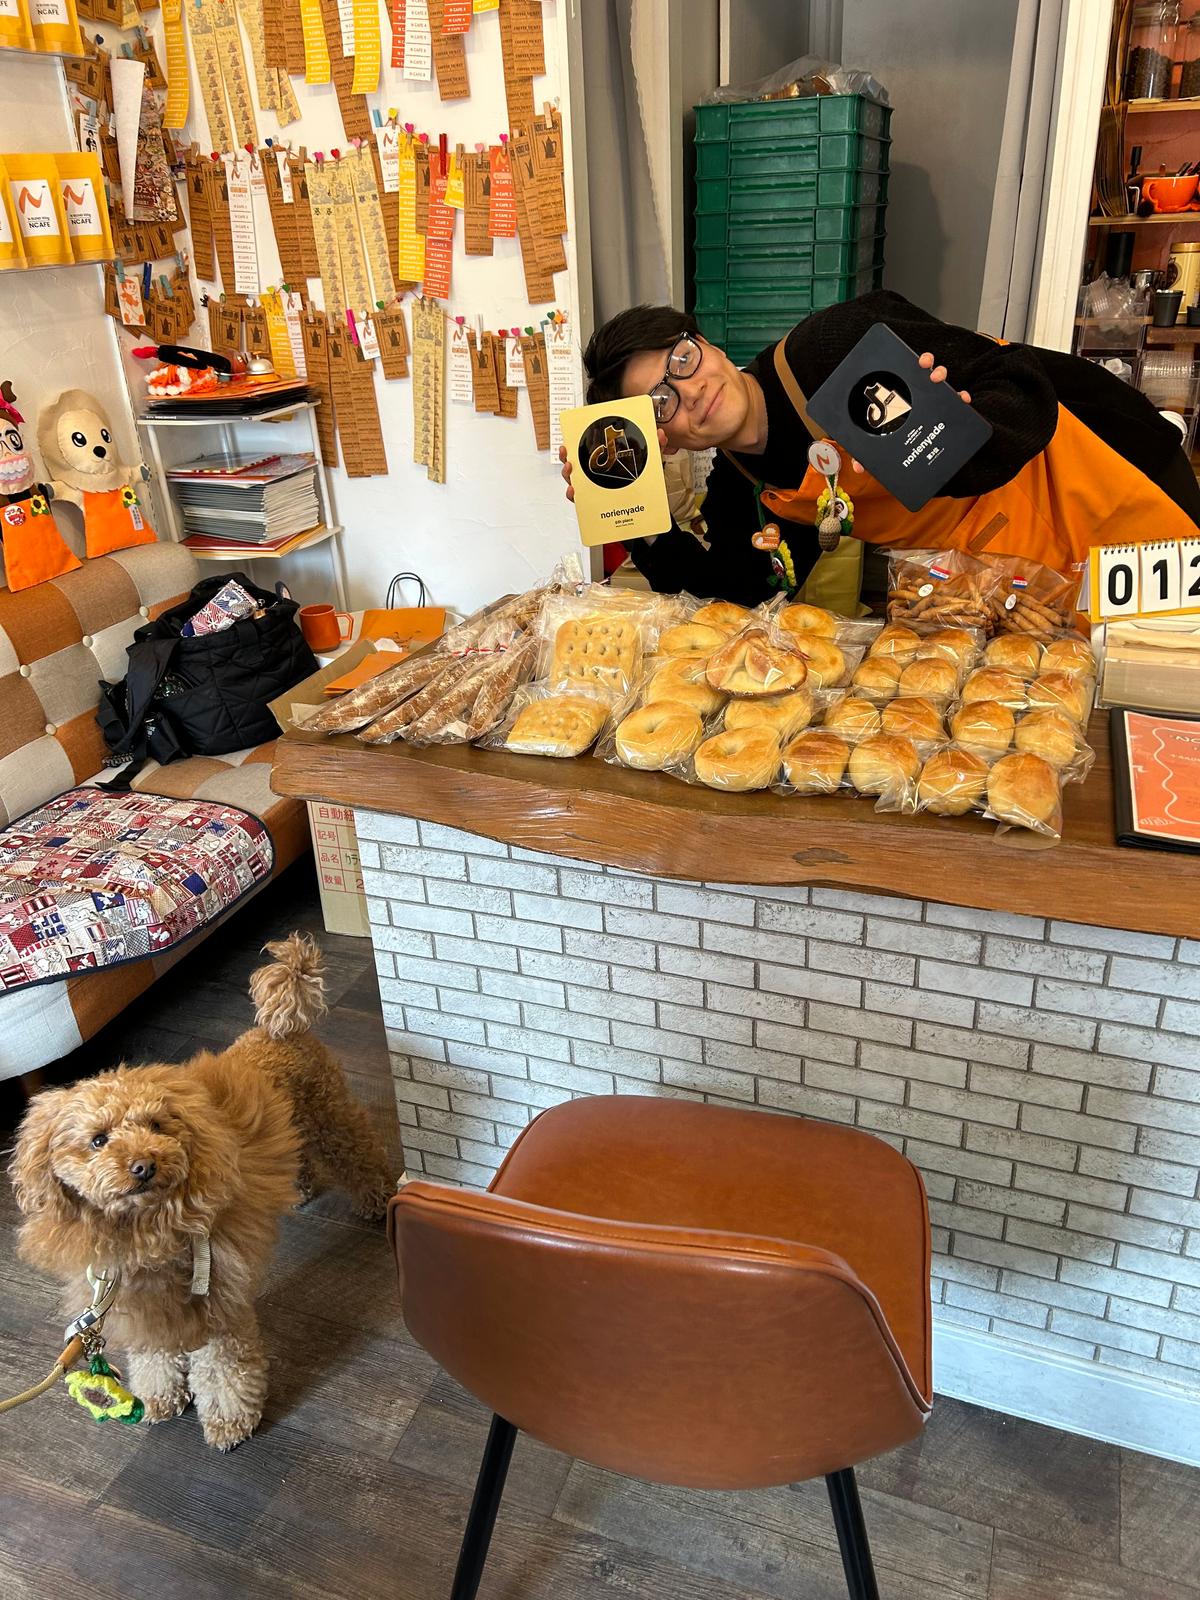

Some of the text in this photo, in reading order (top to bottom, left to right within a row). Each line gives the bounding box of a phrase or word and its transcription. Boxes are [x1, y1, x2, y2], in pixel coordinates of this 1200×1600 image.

[902, 422, 945, 467] norienyade
[600, 505, 645, 519] norienyade
[321, 853, 339, 864] 品名
